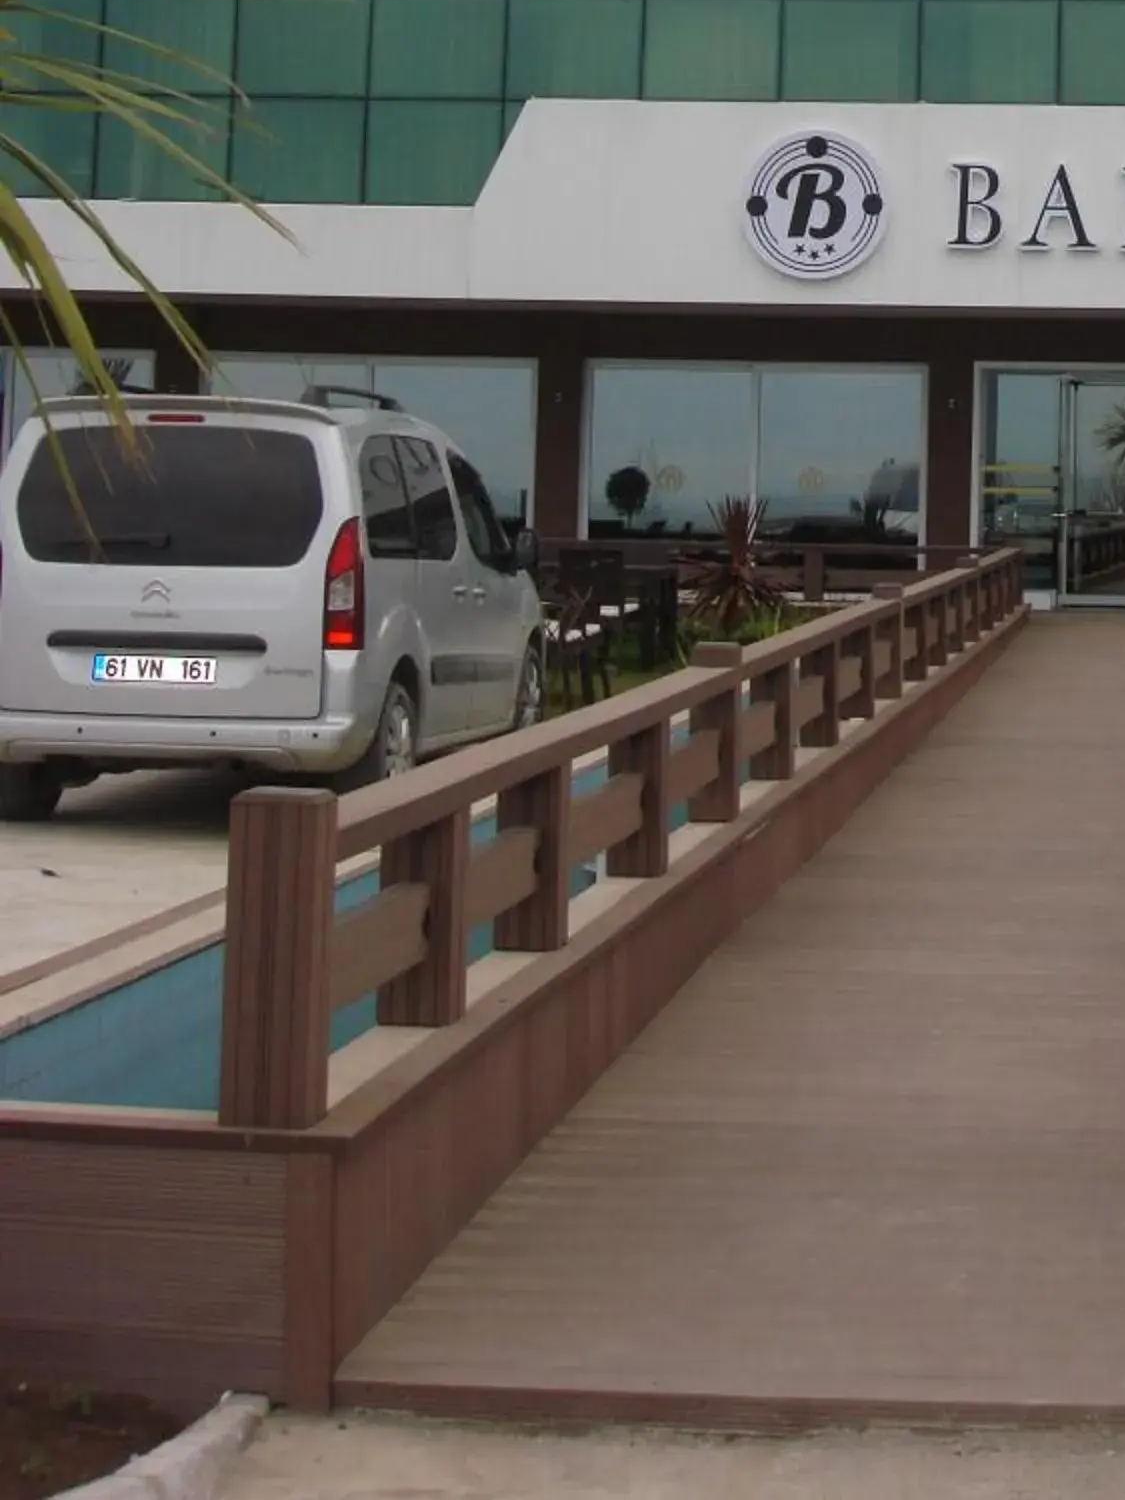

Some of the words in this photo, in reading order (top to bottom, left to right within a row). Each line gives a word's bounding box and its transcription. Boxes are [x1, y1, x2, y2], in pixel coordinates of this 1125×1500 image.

[776, 163, 847, 239] B
[105, 657, 127, 677] 61
[137, 659, 164, 679] VN
[181, 660, 211, 680] 161
